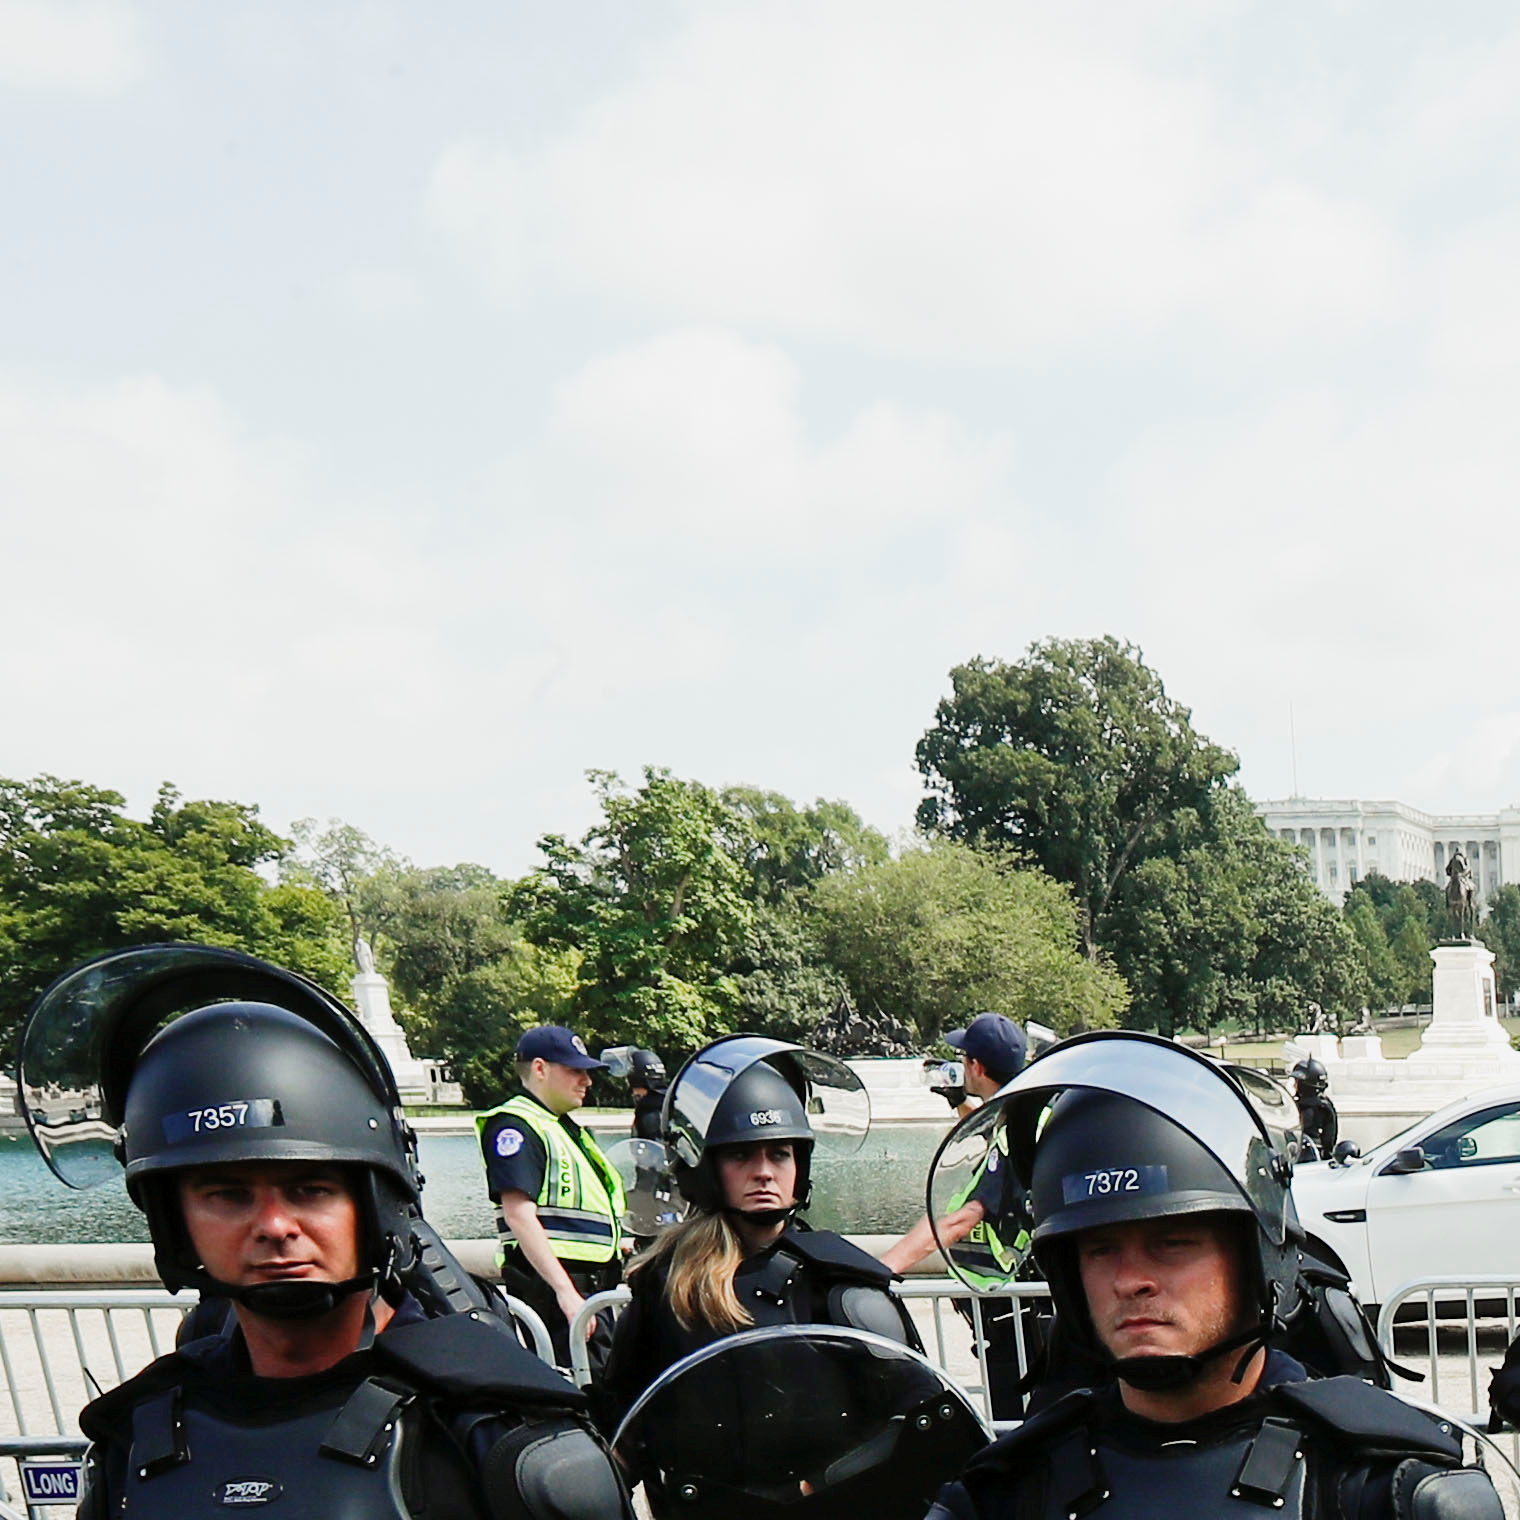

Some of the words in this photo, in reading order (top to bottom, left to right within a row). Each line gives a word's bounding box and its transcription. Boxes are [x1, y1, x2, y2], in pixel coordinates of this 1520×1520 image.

[188, 1104, 248, 1132] 7357
[1085, 1169, 1139, 1195] 7372
[27, 1469, 76, 1495] LONG
